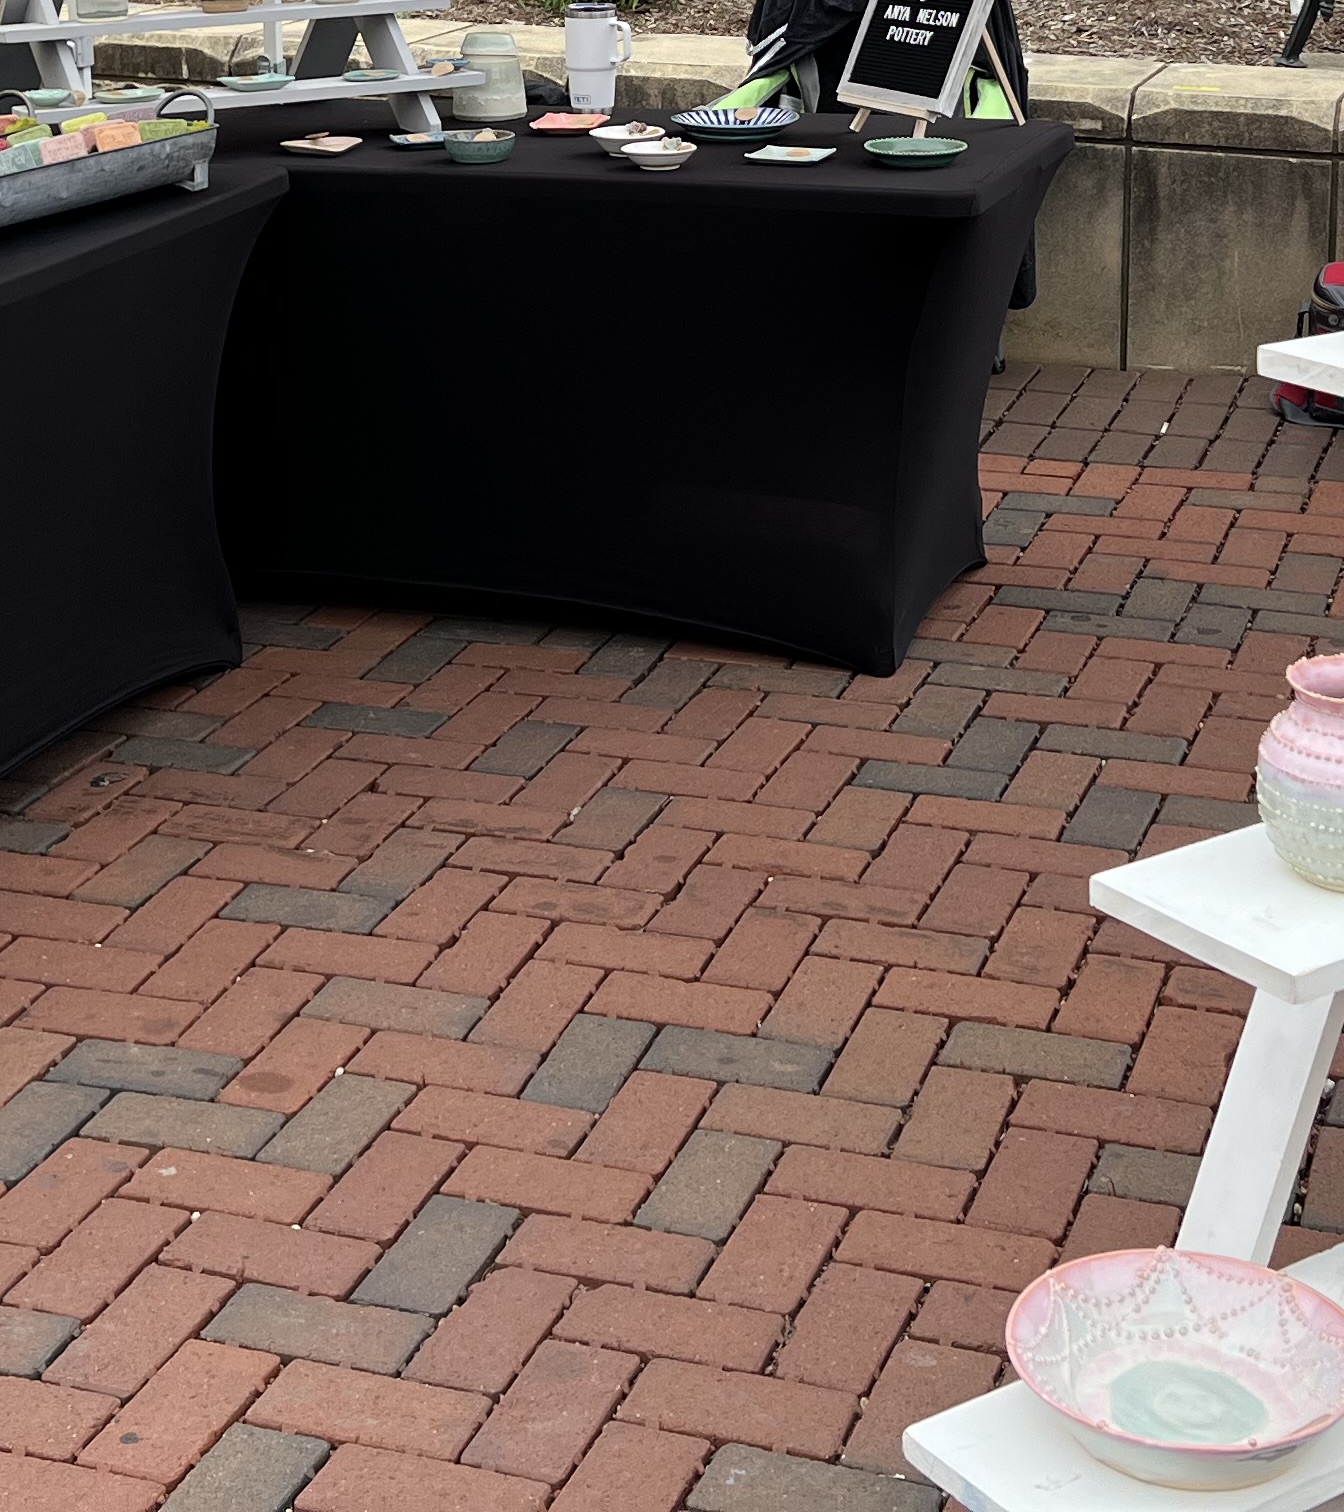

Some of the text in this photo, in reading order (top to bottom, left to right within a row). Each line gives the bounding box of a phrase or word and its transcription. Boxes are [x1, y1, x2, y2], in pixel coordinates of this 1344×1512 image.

[884, 4, 960, 28] ANYA NELSON
[886, 25, 934, 46] POTTERY
